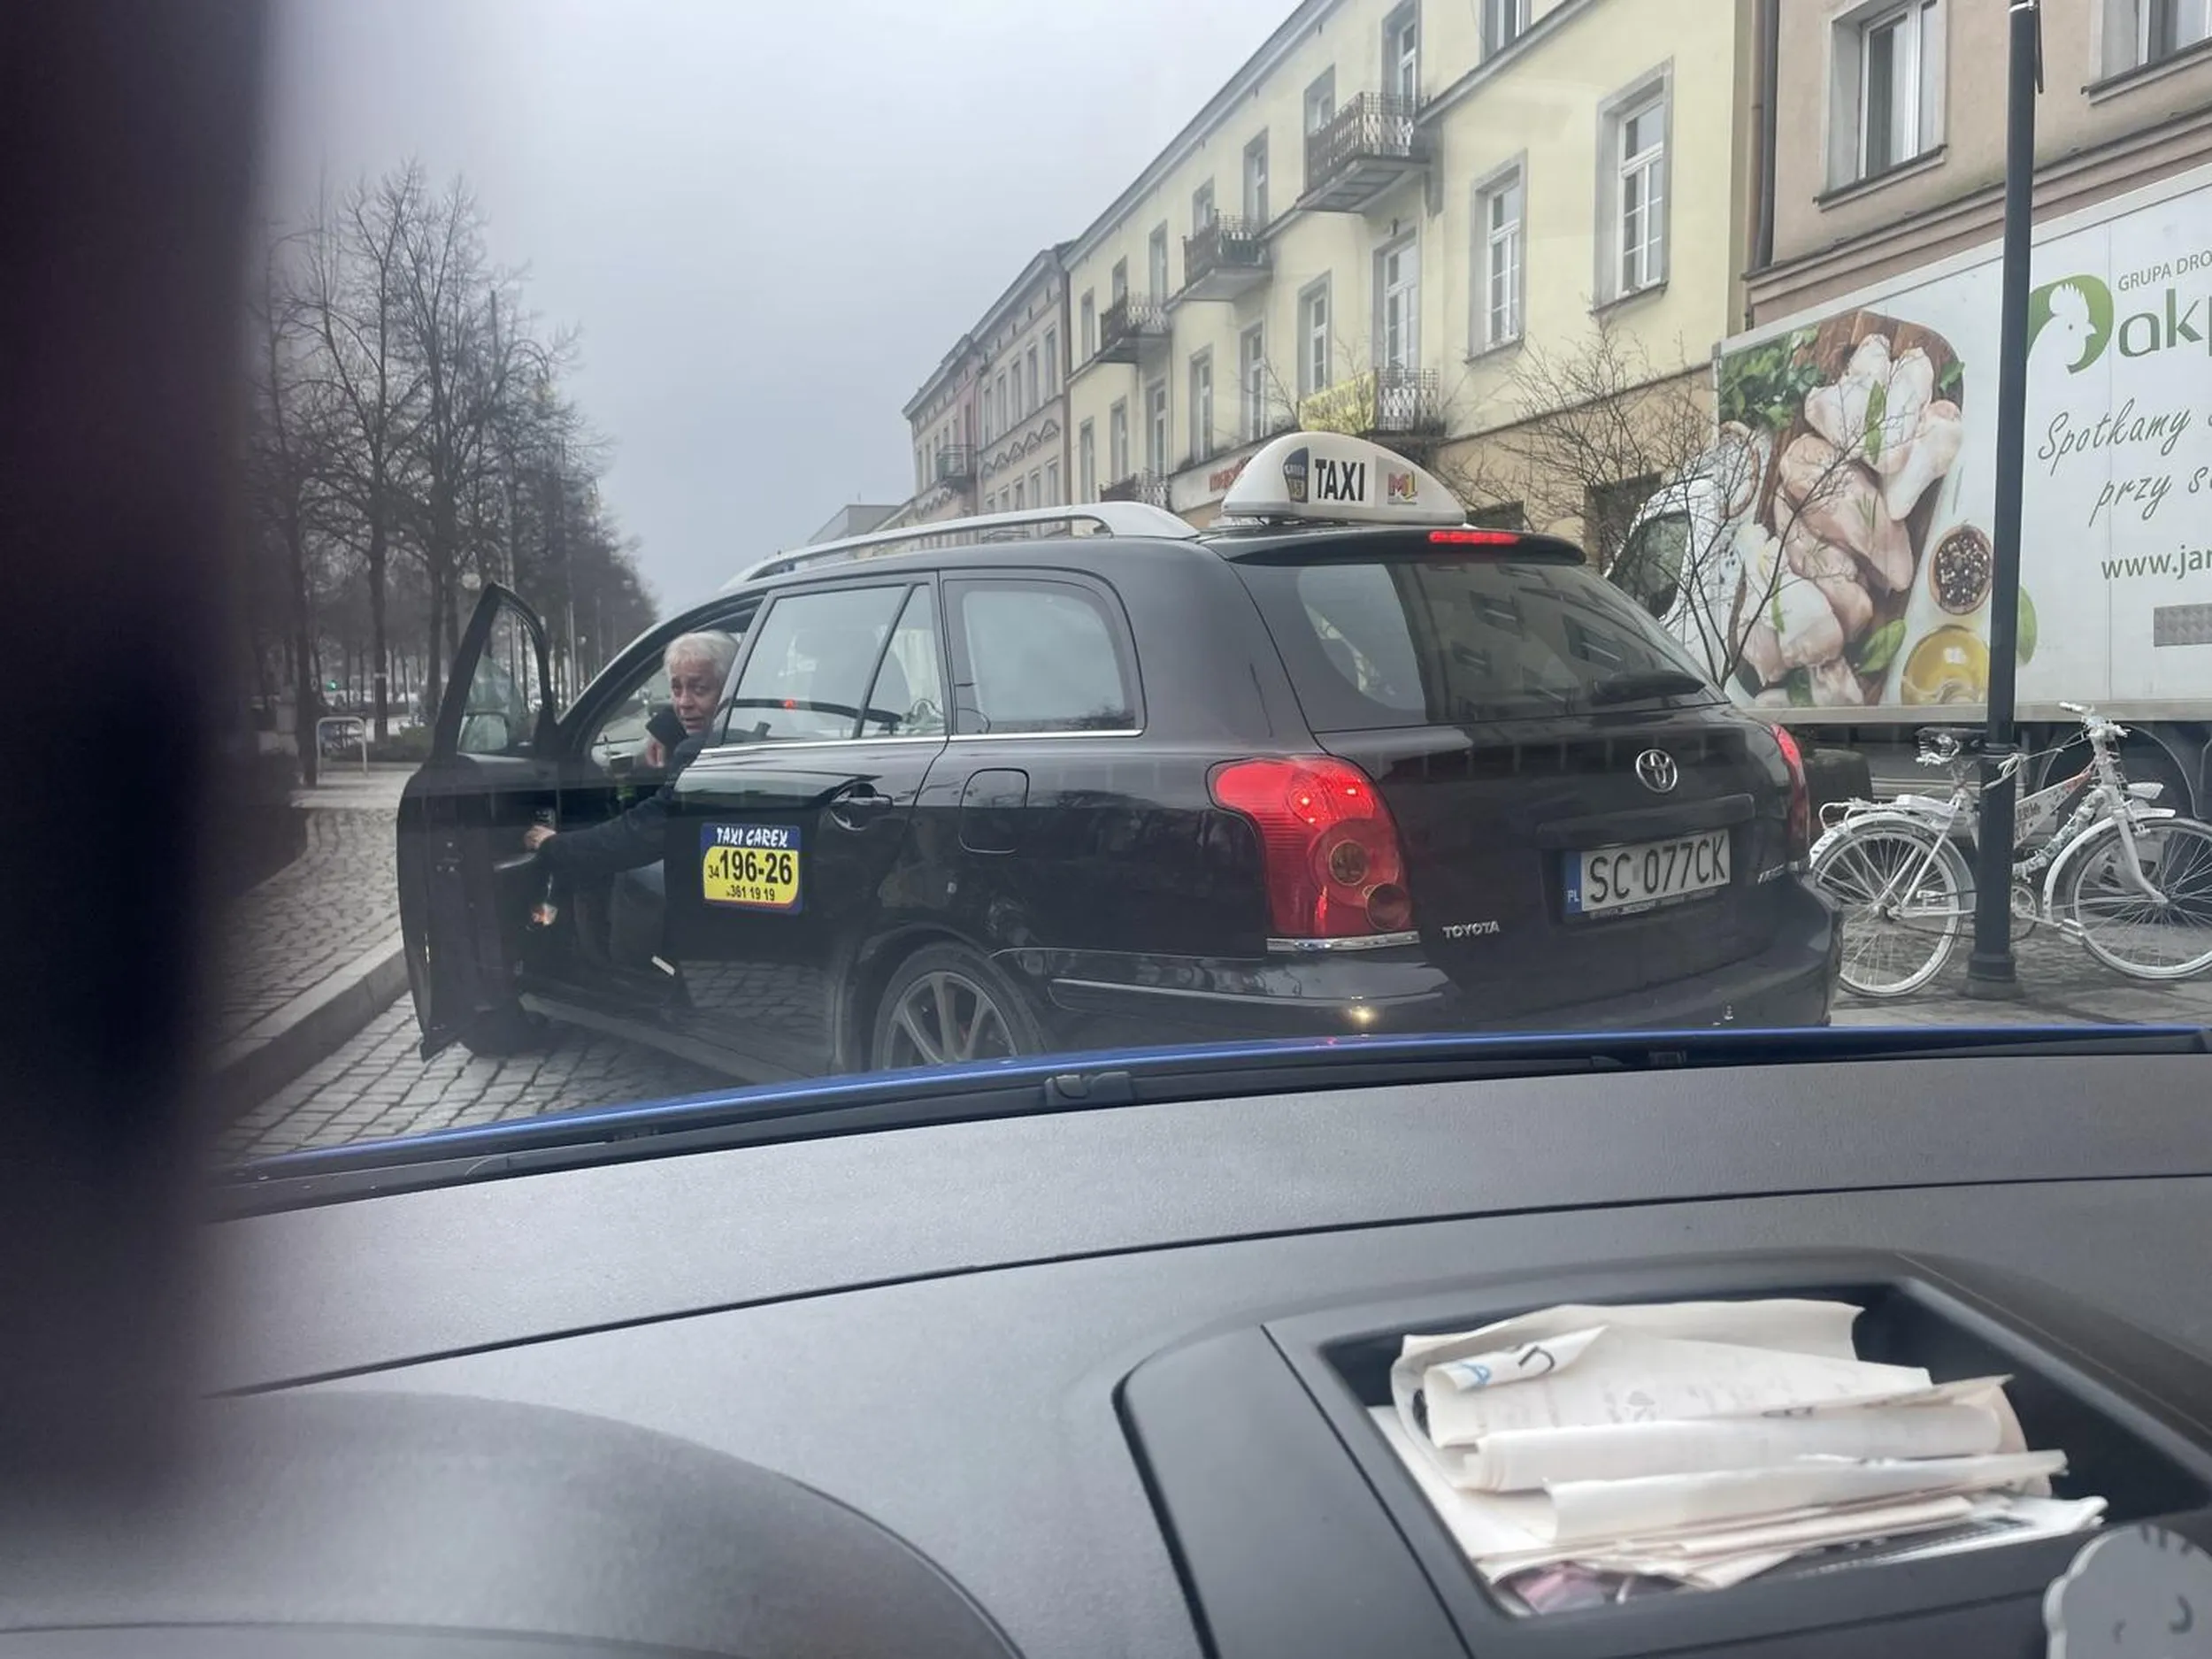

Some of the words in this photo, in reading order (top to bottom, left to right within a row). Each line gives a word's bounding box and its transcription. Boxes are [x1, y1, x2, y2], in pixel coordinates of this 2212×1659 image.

[2118, 263, 2172, 291] GRUPA
[2177, 250, 2212, 275] DRO
[2038, 397, 2192, 477] Spotkamy
[1315, 458, 1365, 502] TAXI
[2088, 475, 2172, 528] przy
[717, 827, 743, 845] TAXI
[720, 849, 793, 885] 196-26
[1590, 853, 1631, 903] SC
[1644, 835, 1725, 895] 077CK
[750, 887, 761, 900] 19
[764, 887, 775, 901] 19
[1567, 891, 1580, 902] PL
[1442, 921, 1500, 938] TOYOTA
